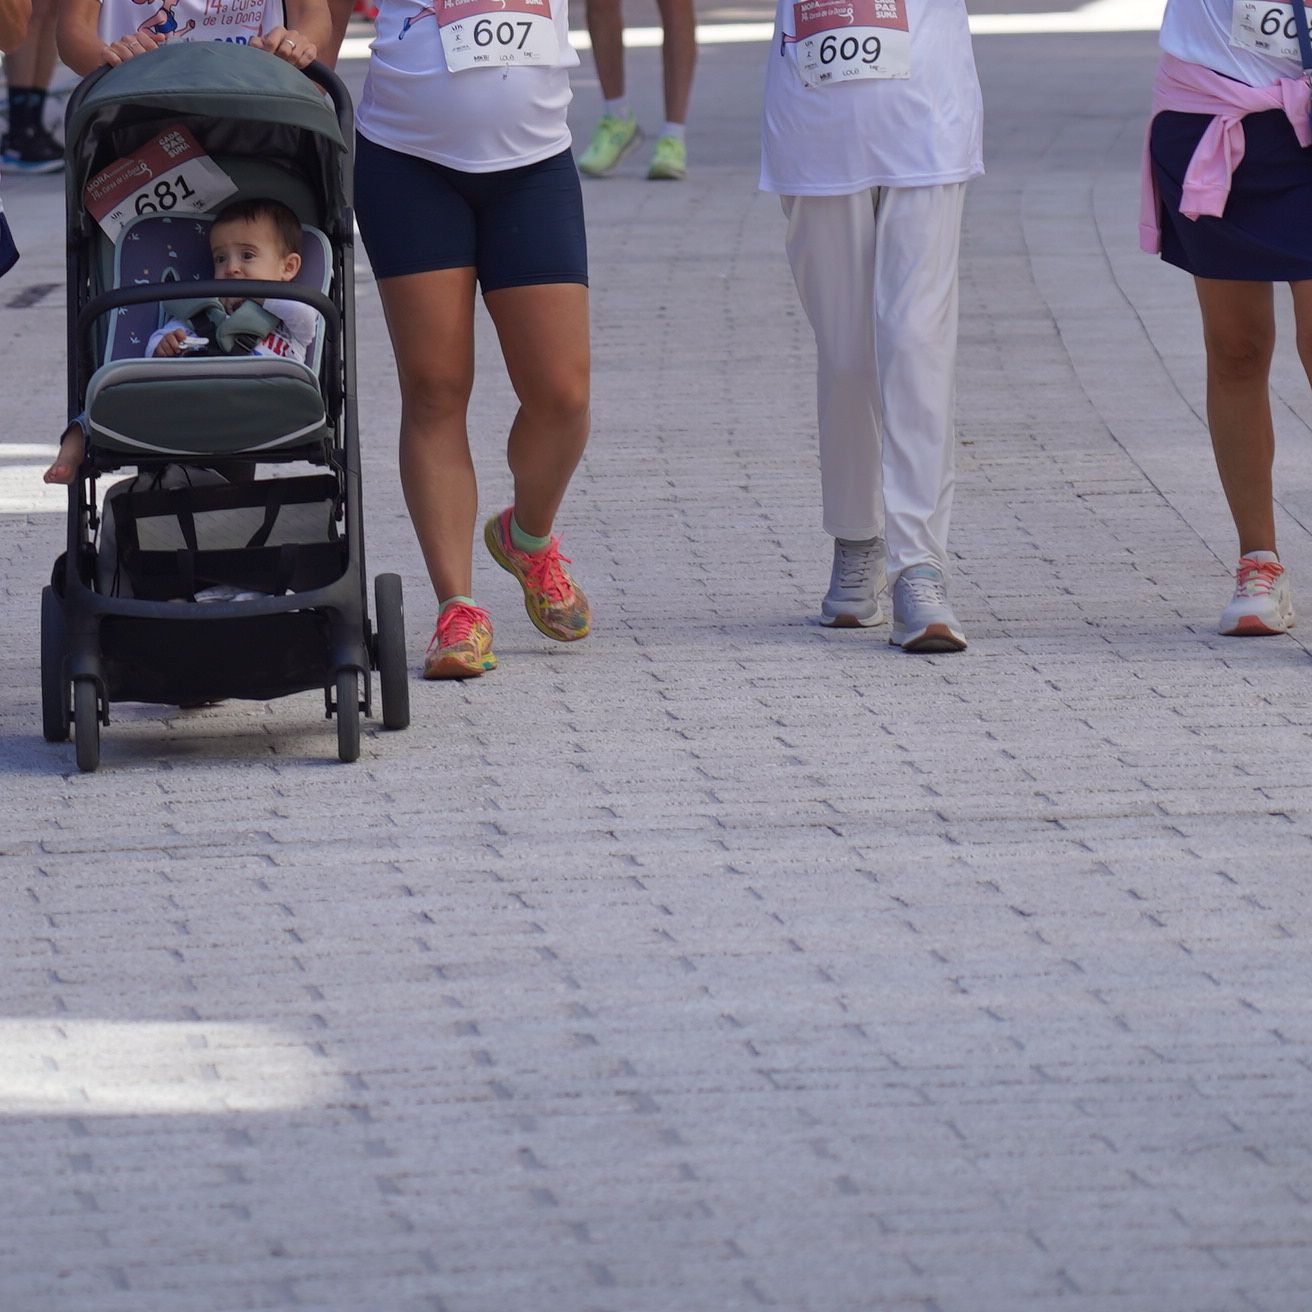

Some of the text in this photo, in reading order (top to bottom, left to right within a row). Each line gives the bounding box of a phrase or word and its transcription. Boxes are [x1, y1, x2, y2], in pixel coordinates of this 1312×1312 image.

[203, 16, 217, 27] de
[235, 9, 262, 25] Dona
[875, 4, 897, 12] PAS
[473, 19, 533, 50] 607
[819, 35, 882, 65] 609
[134, 174, 196, 215] 681
